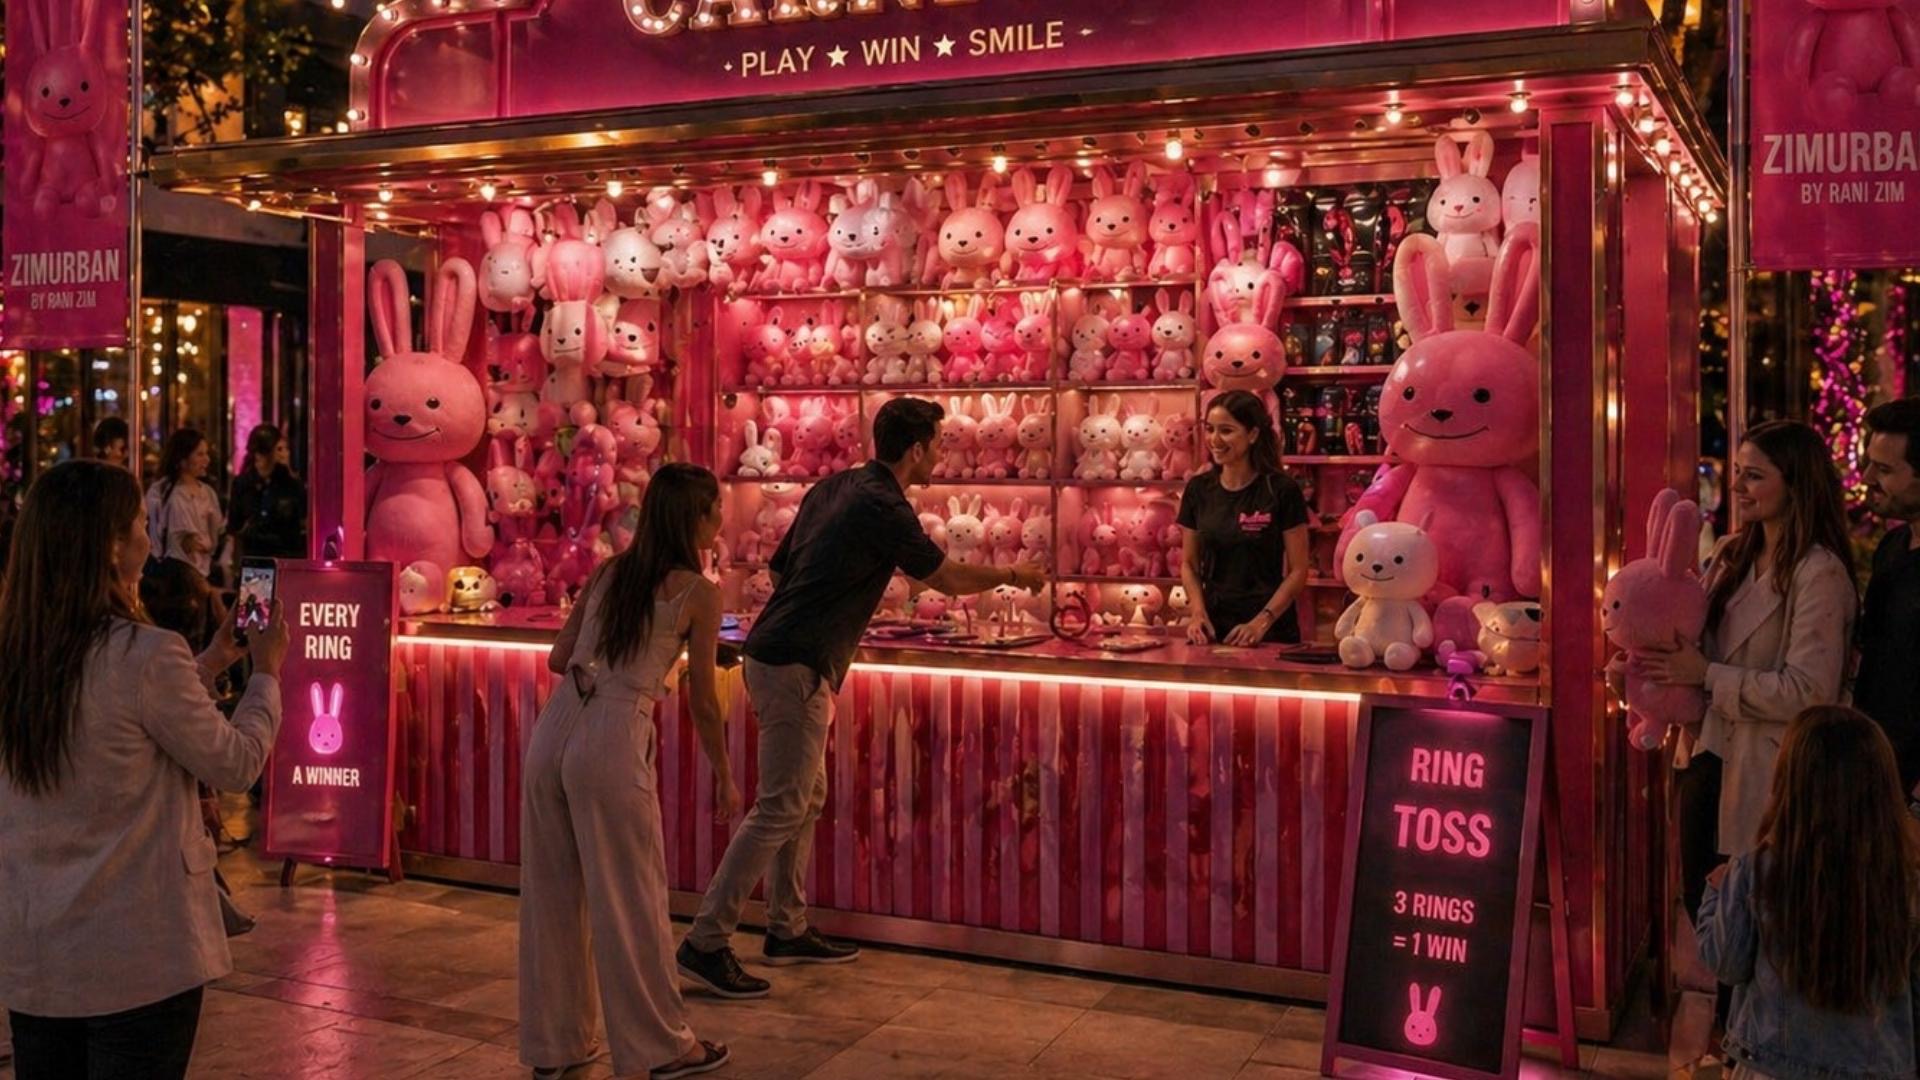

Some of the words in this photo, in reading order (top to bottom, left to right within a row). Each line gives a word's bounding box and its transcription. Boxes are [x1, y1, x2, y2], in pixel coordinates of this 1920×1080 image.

[741, 46, 815, 78] PLAY
[861, 36, 921, 66] WIN
[968, 21, 1064, 55] SMILE
[1762, 131, 1920, 174] ZIMURBA
[1801, 182, 1823, 204] BY
[1829, 181, 1868, 204] RANI
[1874, 181, 1905, 203] ZIM
[11, 248, 119, 286] ZIMURBAN
[31, 292, 45, 310] BY
[76, 290, 97, 308] ZIM
[300, 602, 360, 628] EVERY
[305, 635, 352, 660] RING
[292, 765, 303, 785] A
[306, 766, 360, 787] WINNER
[1410, 748, 1485, 789] RING
[1393, 804, 1493, 859] TOSS
[1393, 891, 1407, 915] 3
[1412, 893, 1475, 924] RINGS
[1412, 932, 1421, 956] 1
[1427, 934, 1467, 964] WIN
